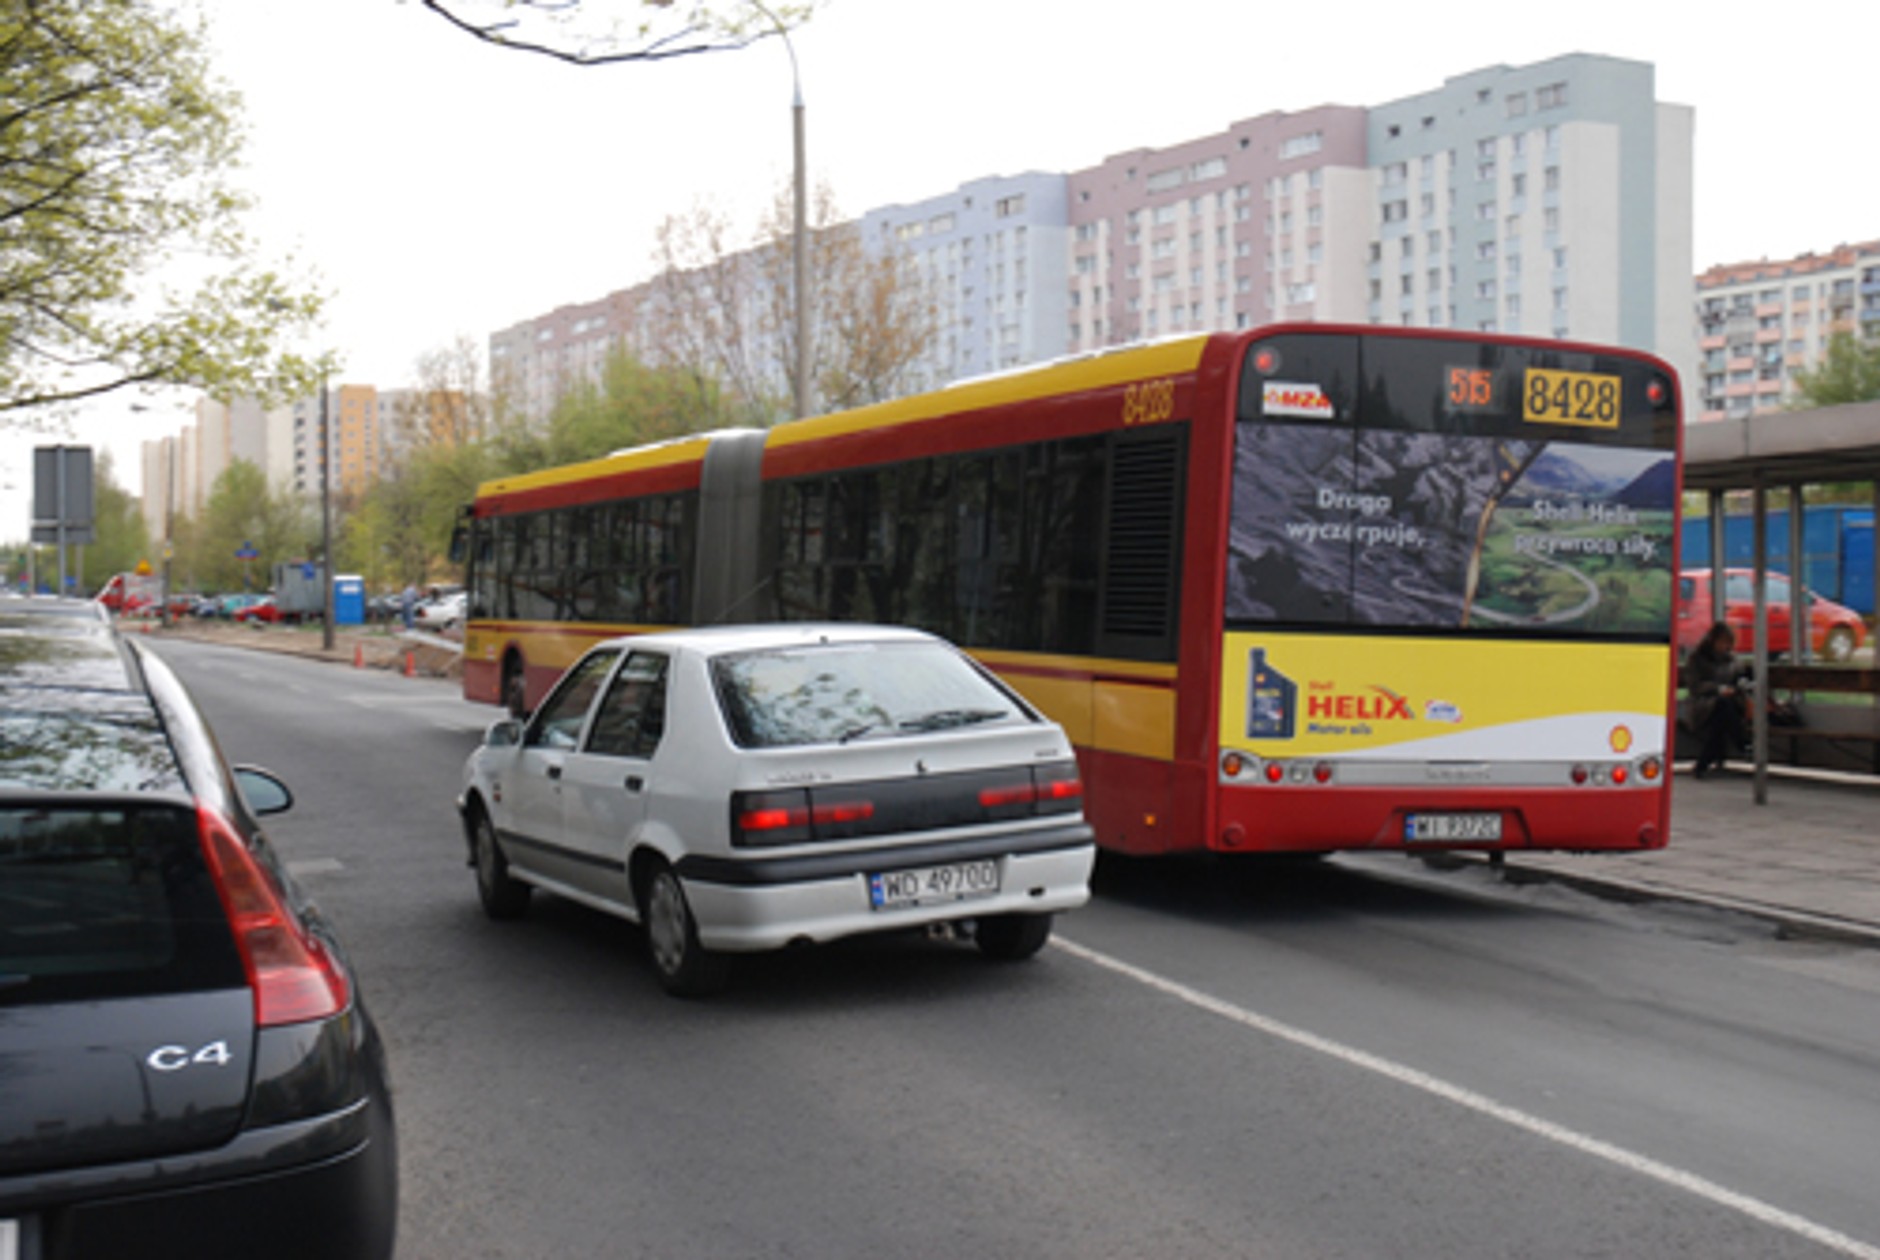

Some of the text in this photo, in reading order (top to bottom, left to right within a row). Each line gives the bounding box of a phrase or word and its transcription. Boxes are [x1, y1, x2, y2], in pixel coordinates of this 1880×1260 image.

[1123, 379, 1174, 425] 8428
[1450, 367, 1492, 405] 515
[1528, 374, 1616, 422] 8428
[1308, 690, 1413, 720] HELIX
[1307, 723, 1347, 735] Motor
[147, 1041, 232, 1071] C4
